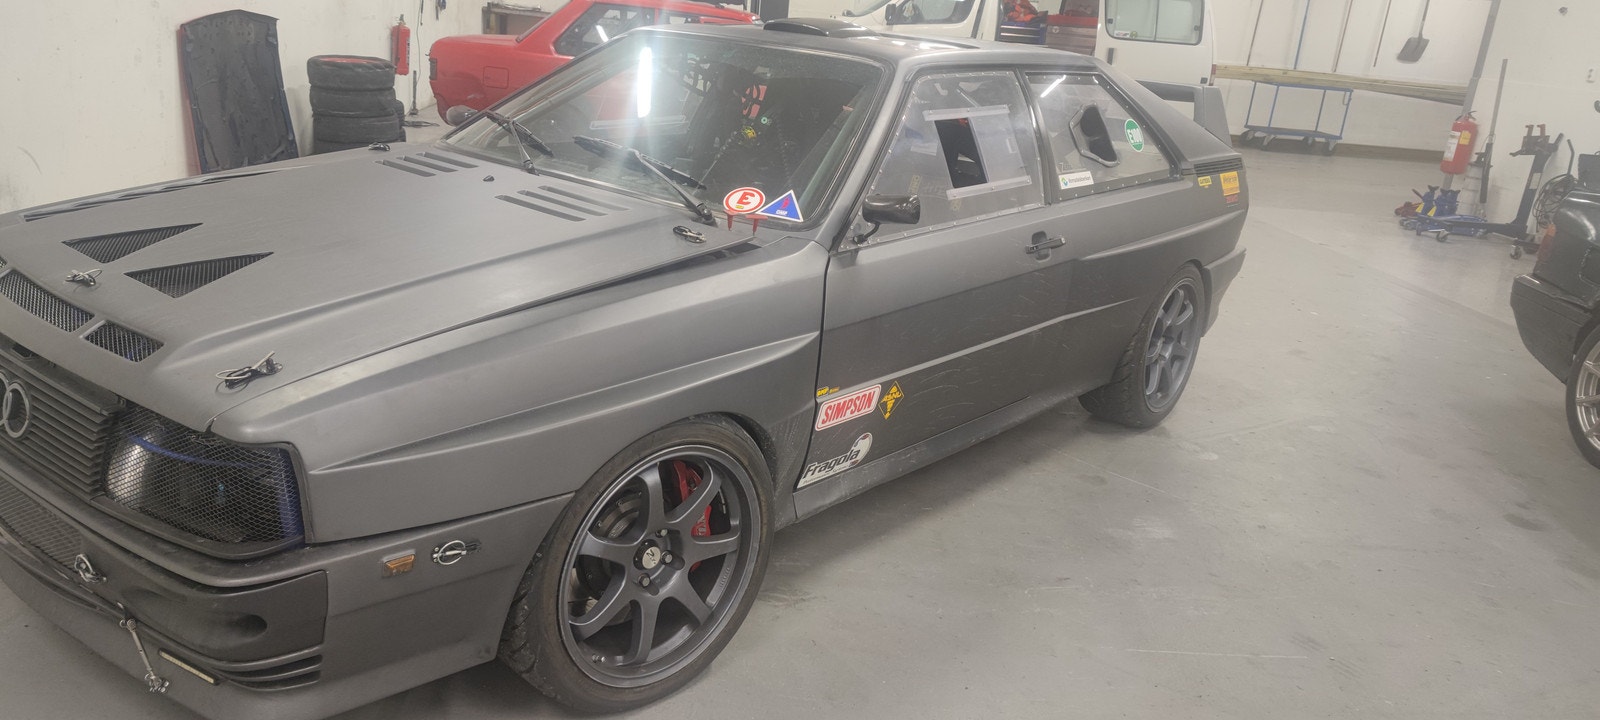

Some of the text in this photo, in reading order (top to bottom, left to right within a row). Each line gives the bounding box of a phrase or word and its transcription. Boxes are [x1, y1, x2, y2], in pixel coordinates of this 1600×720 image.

[736, 191, 755, 205] E
[822, 391, 876, 424] SIMPSON
[803, 449, 861, 479] Fragola
